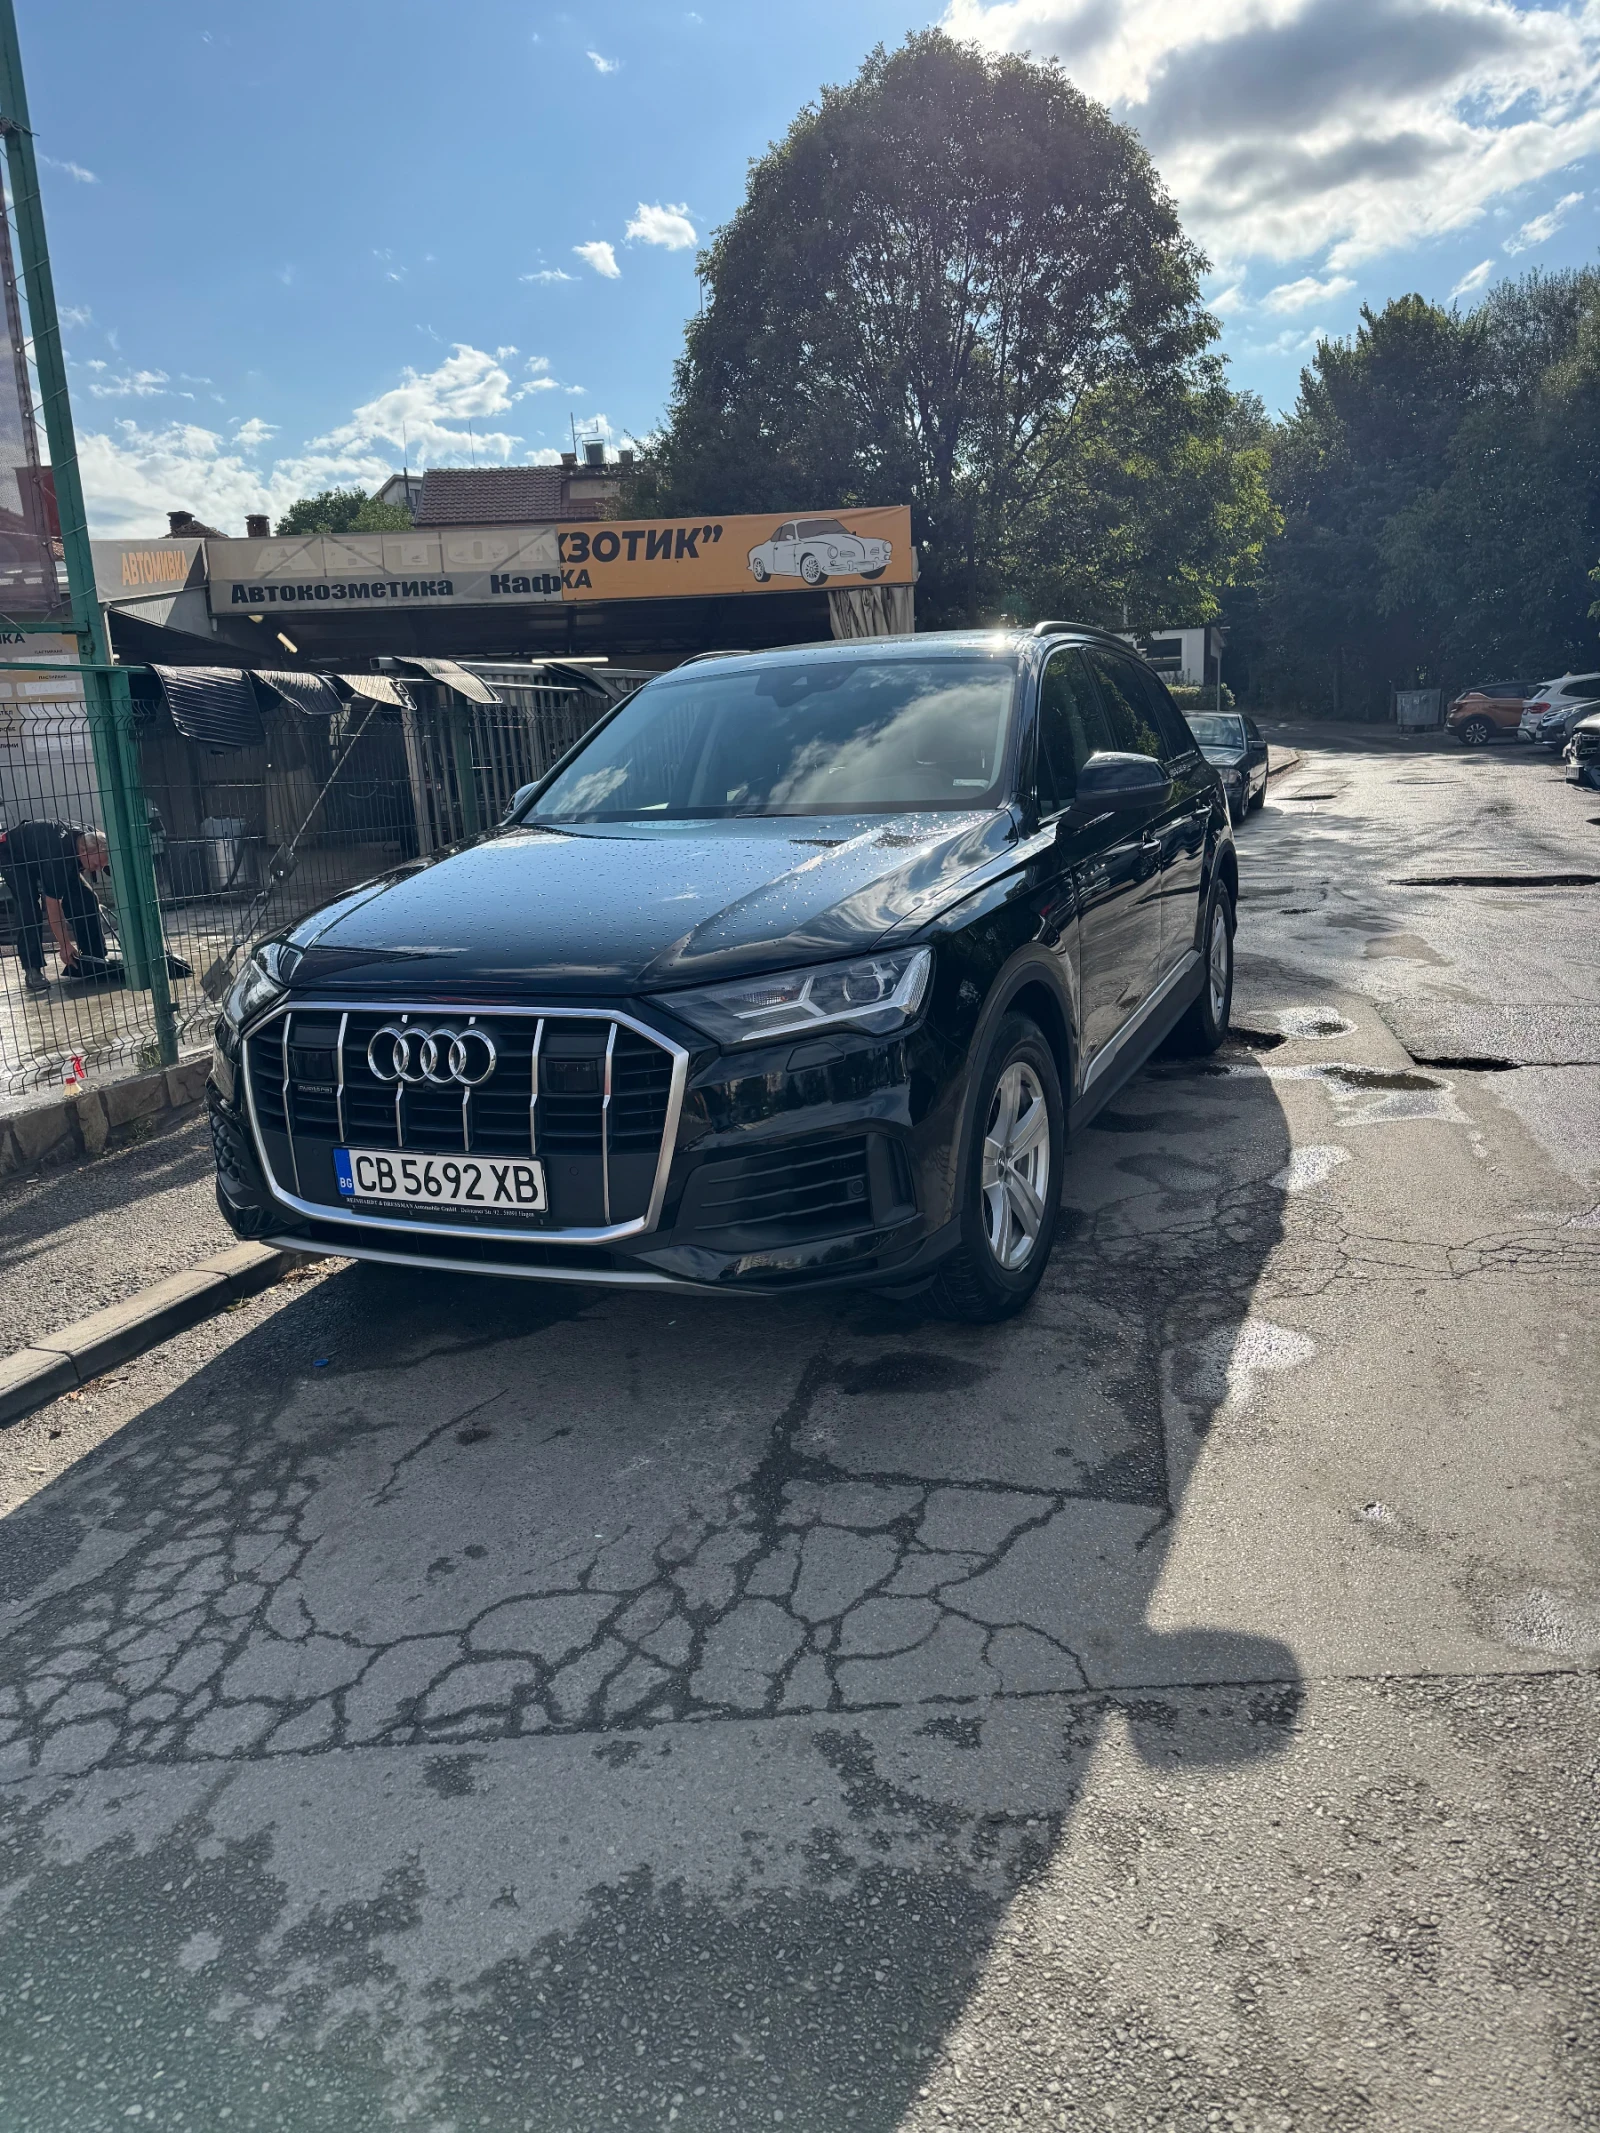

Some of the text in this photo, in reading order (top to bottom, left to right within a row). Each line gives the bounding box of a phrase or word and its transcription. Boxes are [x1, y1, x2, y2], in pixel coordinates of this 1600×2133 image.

[121, 550, 188, 586] АВТОМИВКА
[231, 574, 561, 604] Автокозметика Каф
[340, 1177, 353, 1189] BG
